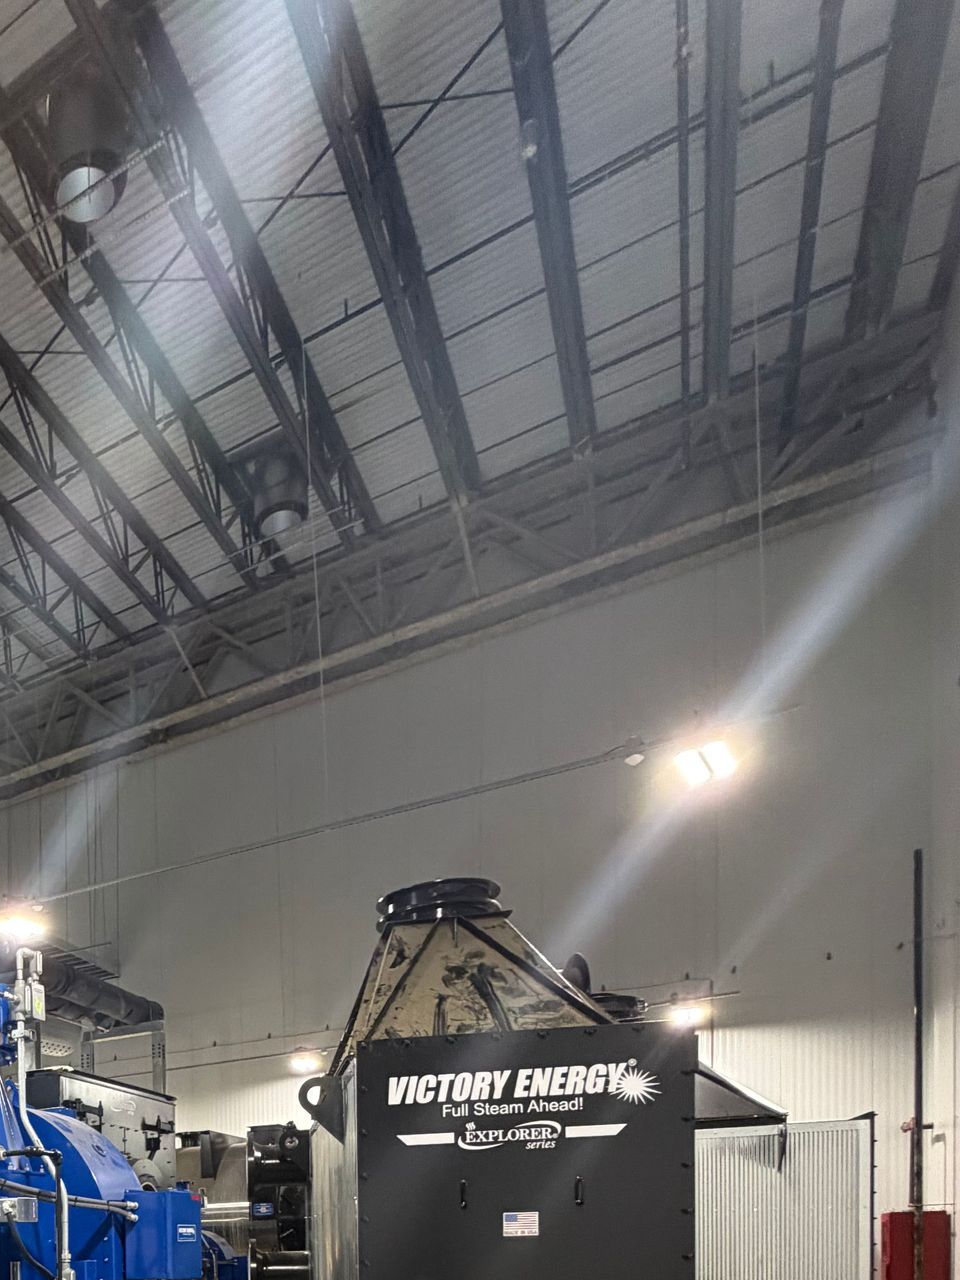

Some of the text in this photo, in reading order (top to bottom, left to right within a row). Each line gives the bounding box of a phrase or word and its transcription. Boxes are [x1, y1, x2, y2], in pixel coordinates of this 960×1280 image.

[388, 1062, 627, 1106] VICTORY ENERGY
[442, 1097, 584, 1118] Full Steam Ahead!
[465, 1127, 553, 1143] EXPLORER
[525, 1139, 557, 1150] series
